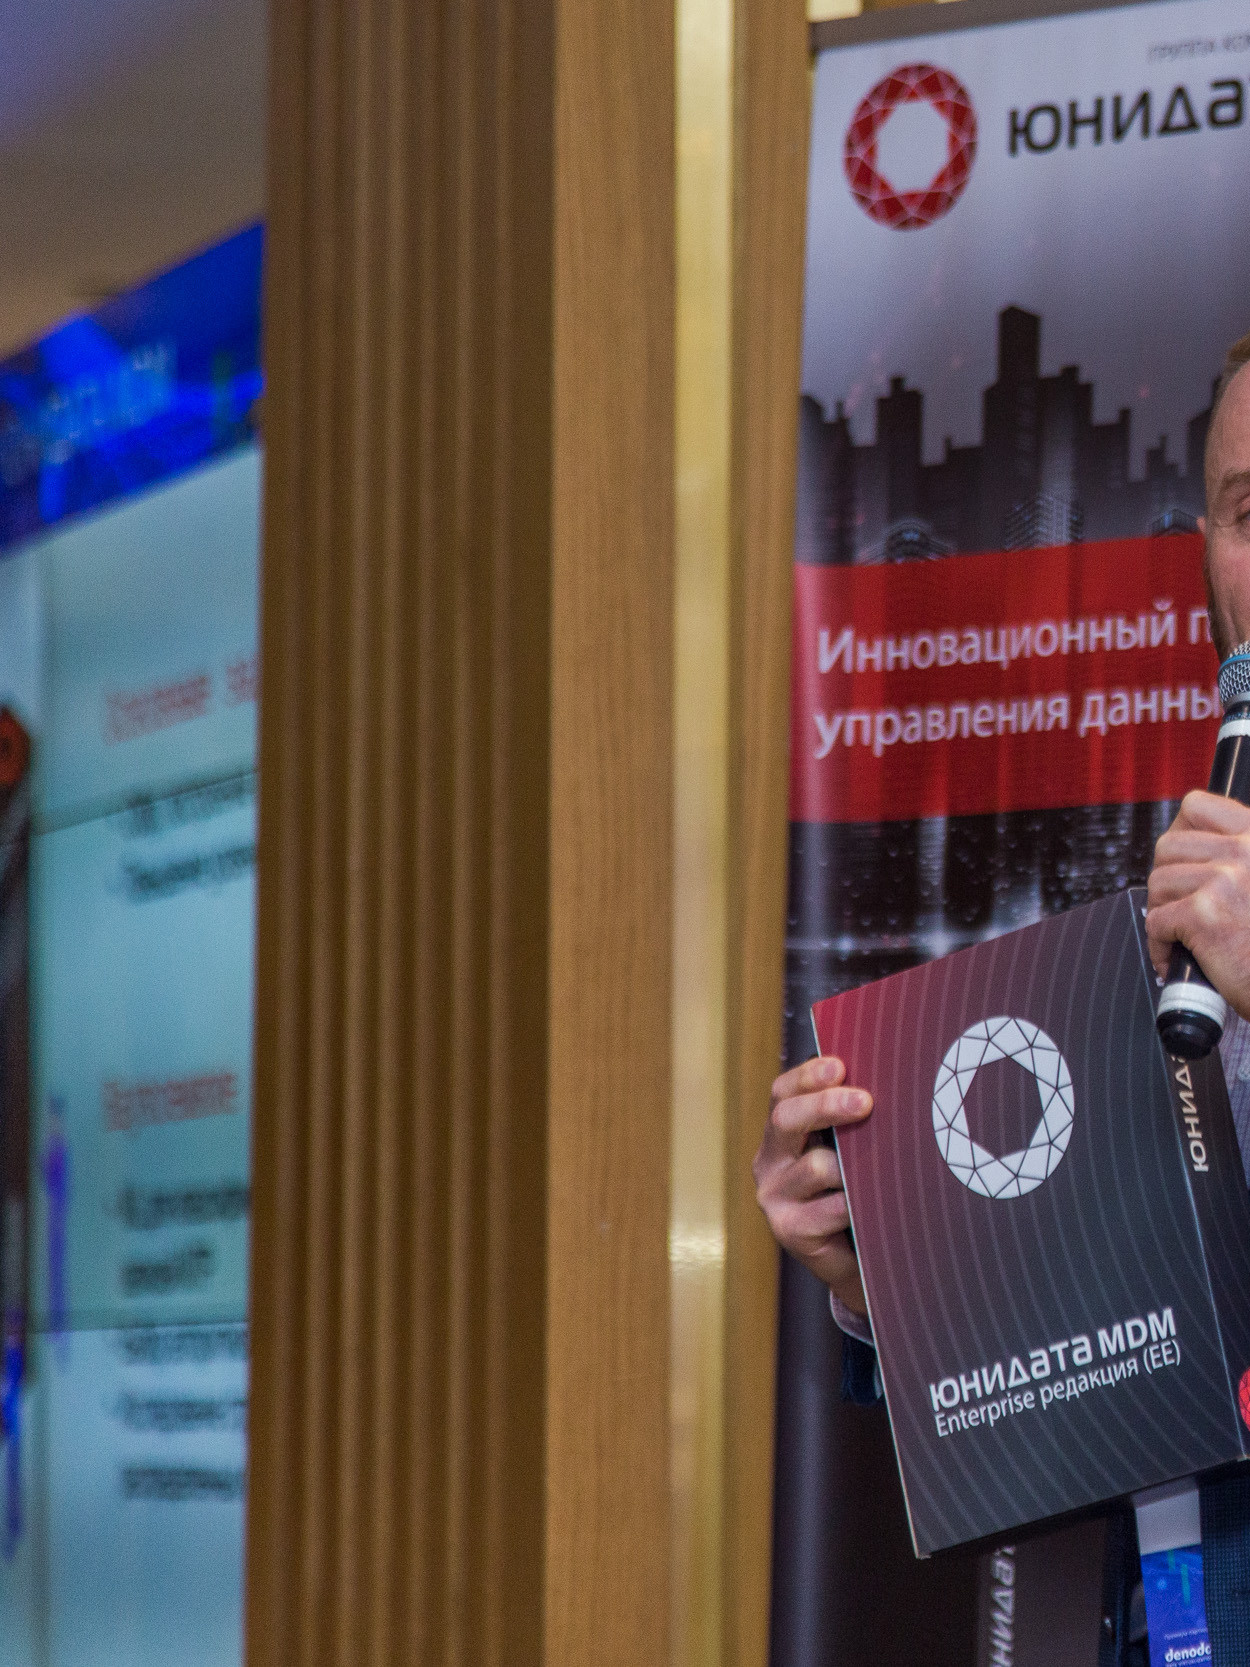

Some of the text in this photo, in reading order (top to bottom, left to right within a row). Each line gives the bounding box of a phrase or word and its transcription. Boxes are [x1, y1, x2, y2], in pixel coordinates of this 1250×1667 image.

[817, 599, 1177, 674] Инновационный
[813, 692, 1071, 759] управления
[1097, 1306, 1177, 1359] MDM
[934, 1389, 1036, 1438] Enterprise
[1039, 1356, 1139, 1411] редакция
